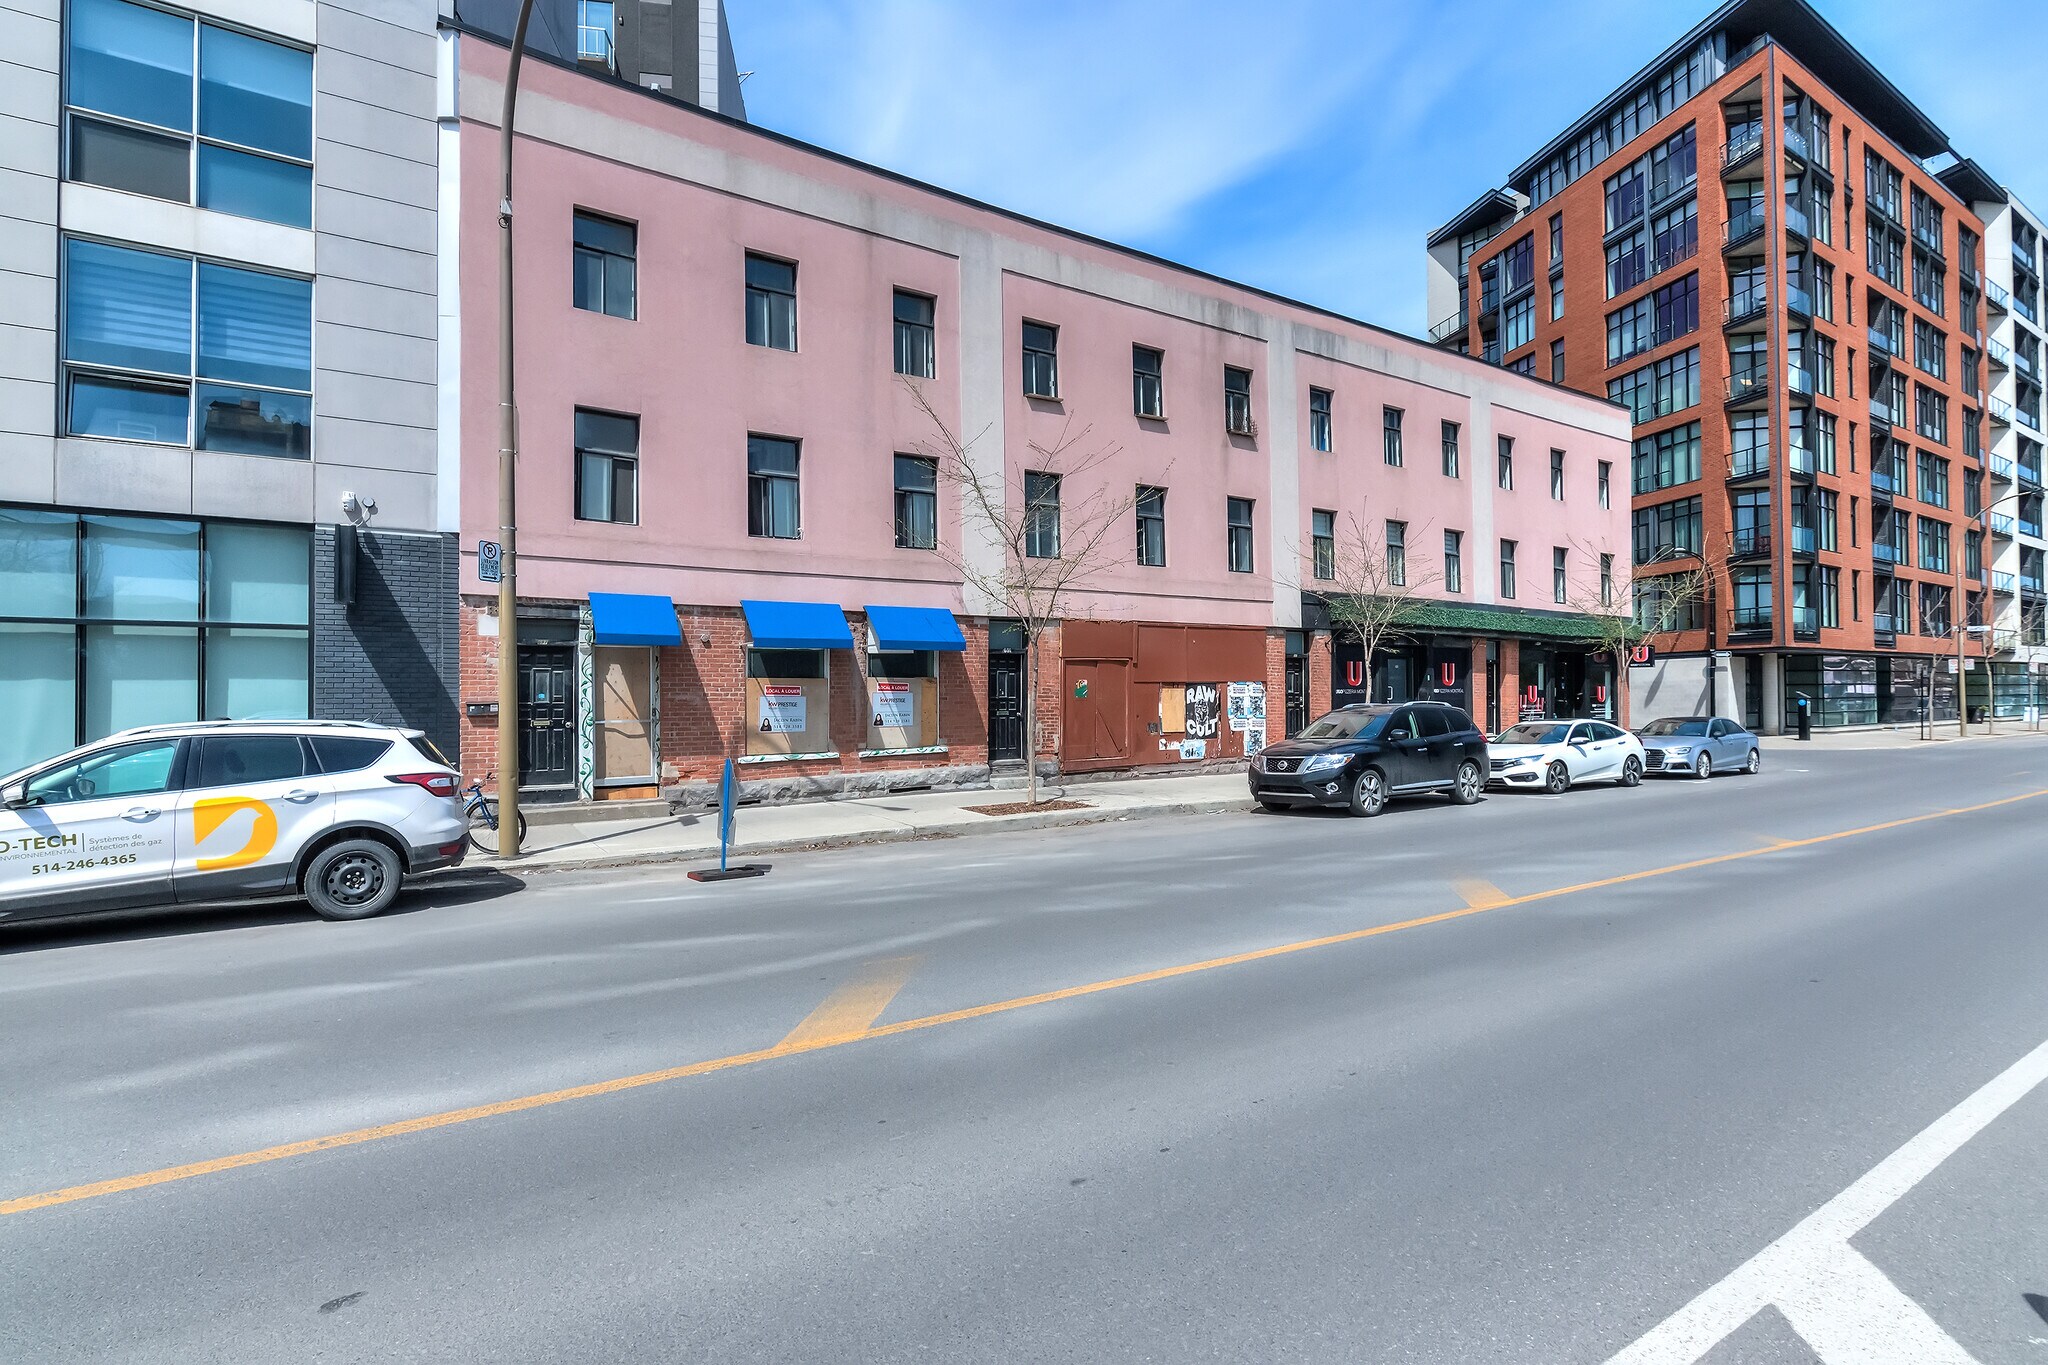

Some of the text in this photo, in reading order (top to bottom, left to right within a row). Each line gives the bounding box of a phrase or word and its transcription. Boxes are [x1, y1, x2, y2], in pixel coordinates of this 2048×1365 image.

[1347, 661, 1362, 687] U
[1442, 663, 1455, 687] U
[1186, 685, 1216, 704] RAW
[1597, 685, 1606, 703] U
[1186, 718, 1219, 737] CULT
[88, 835, 130, 845] Systèmes
[89, 843, 129, 852] détection
[147, 839, 162, 847] gaz
[32, 853, 137, 875] 514-246-4365
